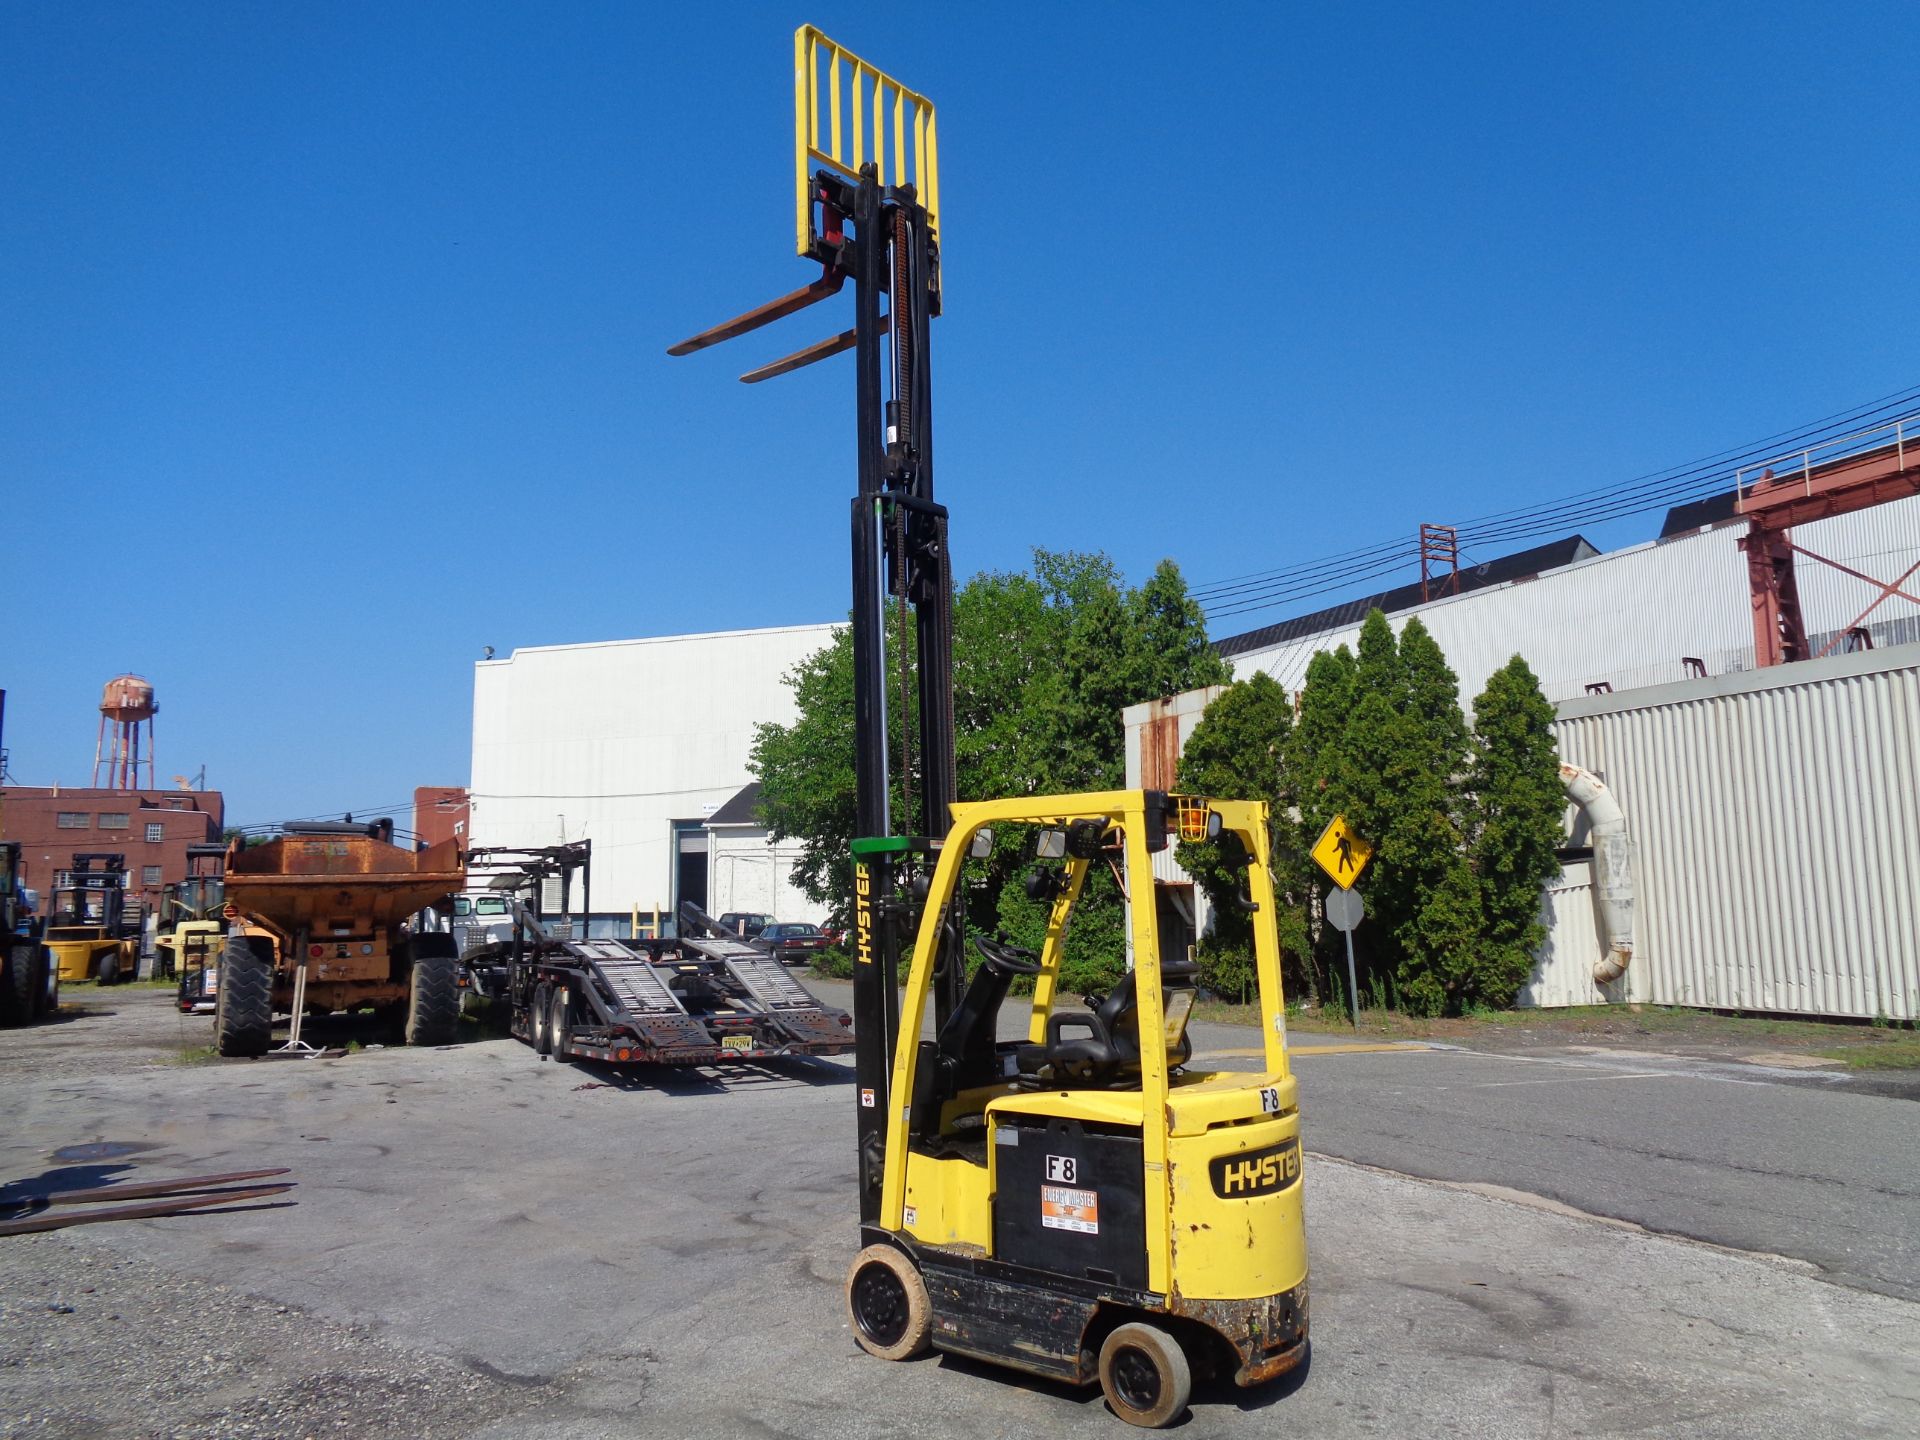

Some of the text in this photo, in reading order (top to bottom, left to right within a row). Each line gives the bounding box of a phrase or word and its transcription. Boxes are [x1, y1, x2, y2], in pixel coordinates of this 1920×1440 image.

[856, 862, 872, 964] HYSTER
[1224, 1146, 1300, 1194] HYSTER
[1043, 1187, 1096, 1208] ENERGY MASTER
